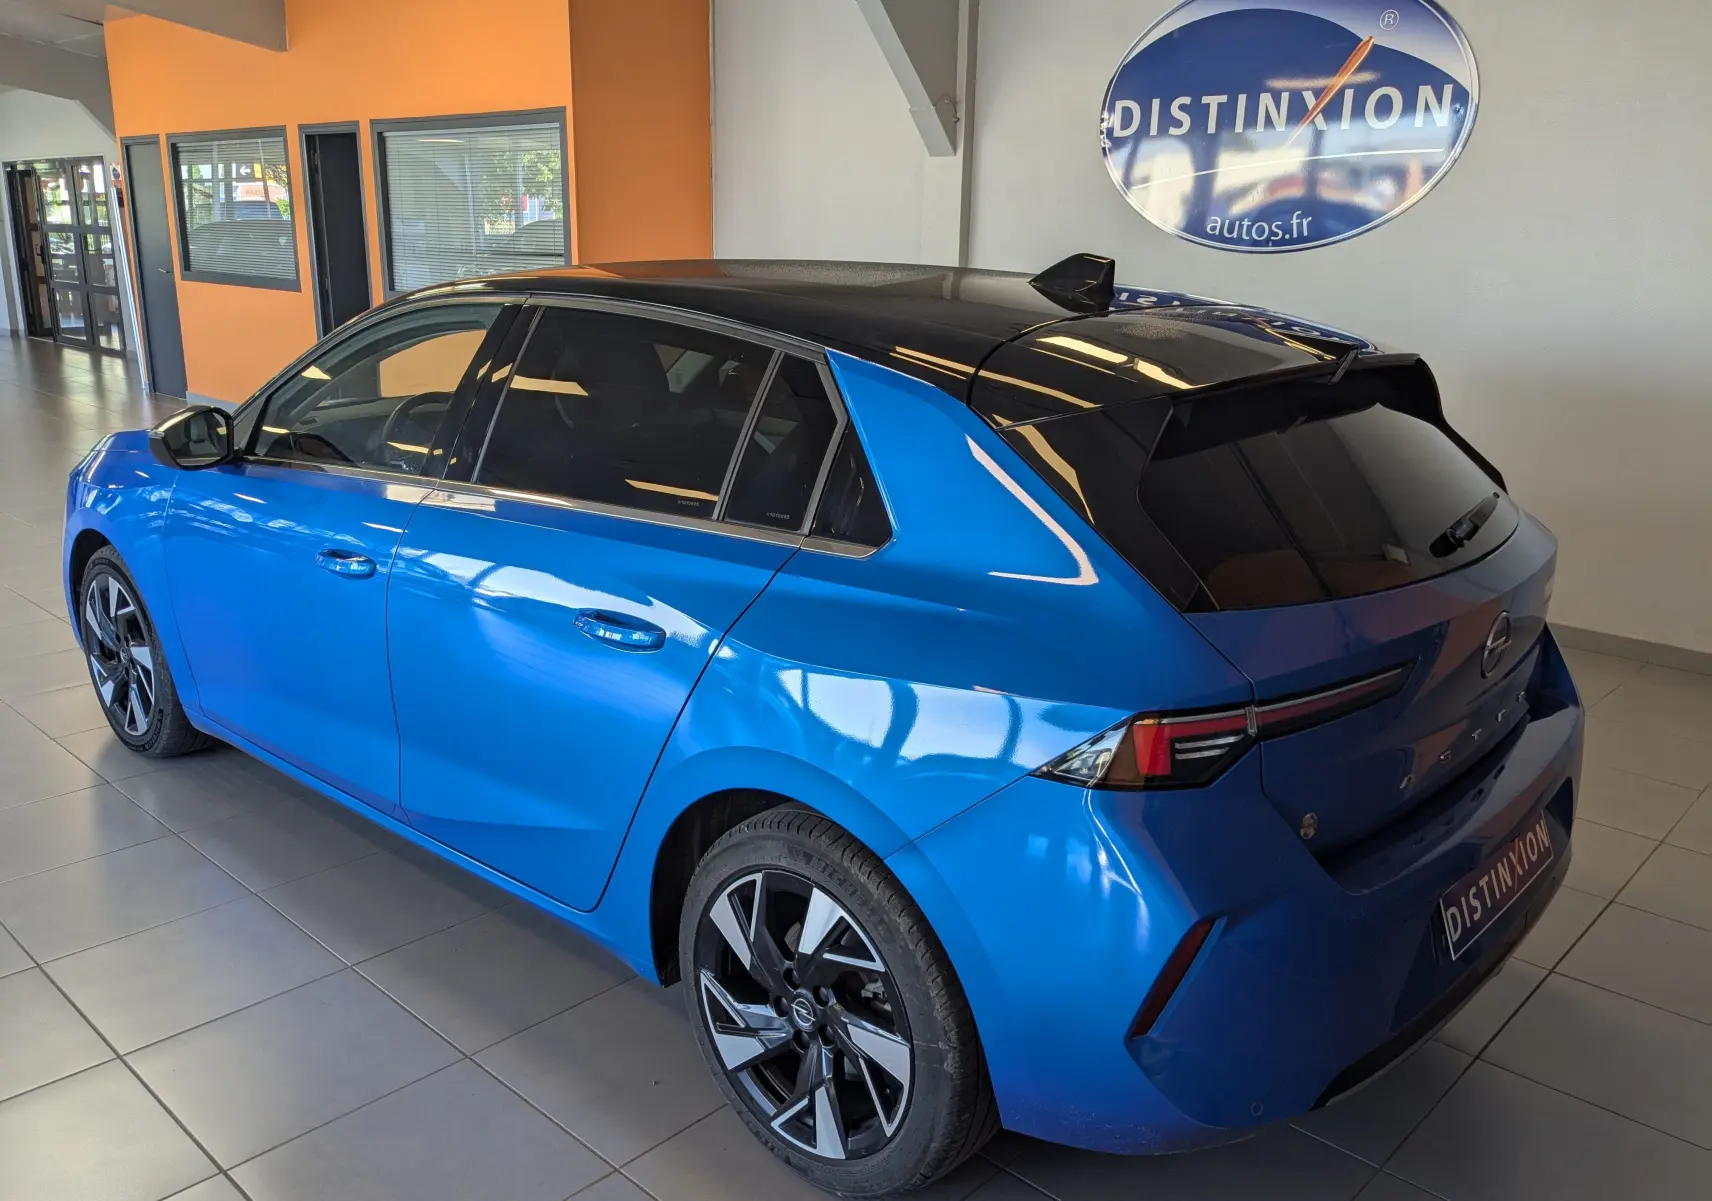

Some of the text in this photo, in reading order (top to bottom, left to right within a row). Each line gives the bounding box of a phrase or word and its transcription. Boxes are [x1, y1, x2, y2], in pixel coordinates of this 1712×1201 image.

[1112, 84, 1453, 138] DISTINXION
[1206, 211, 1312, 241] autos.fr
[1446, 819, 1549, 943] DISTINXION
